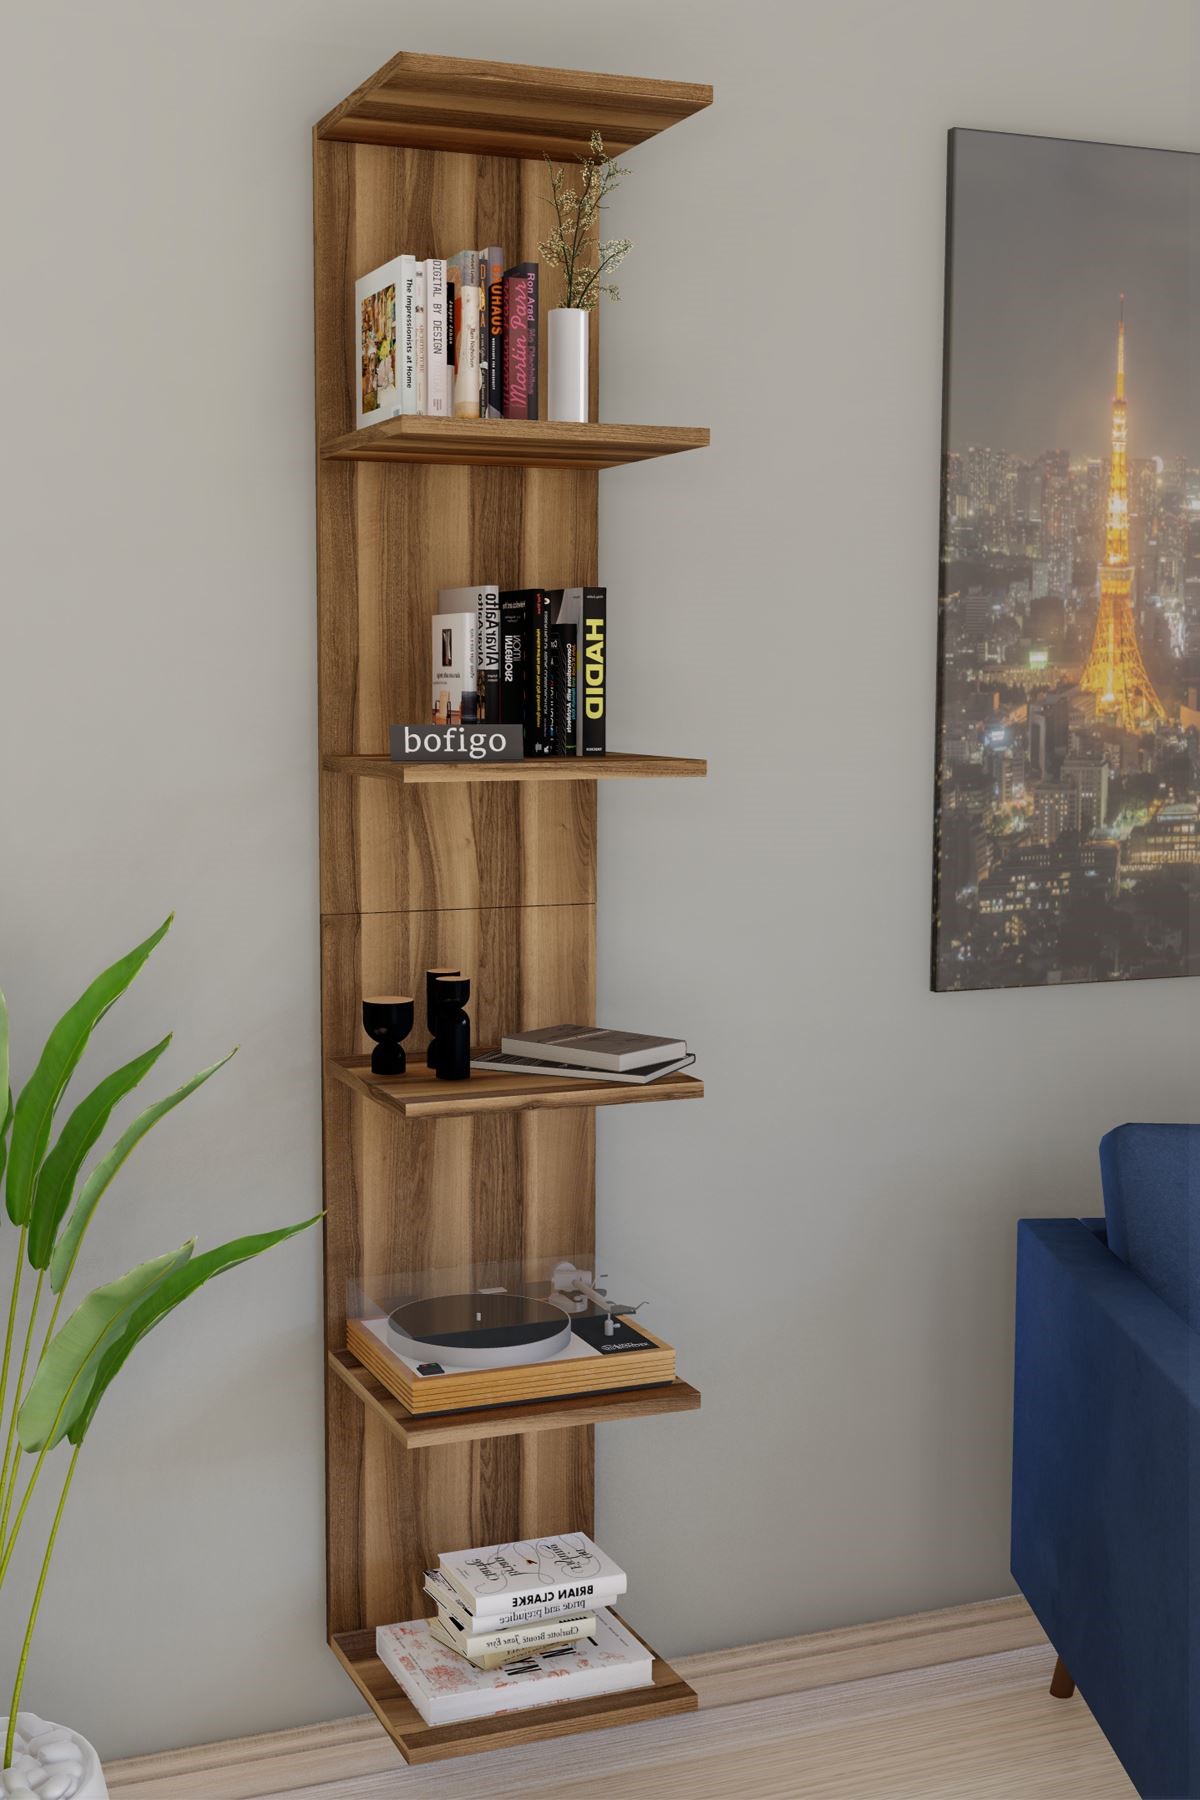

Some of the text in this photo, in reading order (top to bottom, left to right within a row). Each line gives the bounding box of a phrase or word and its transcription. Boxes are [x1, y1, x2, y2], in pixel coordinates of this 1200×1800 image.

[405, 295, 413, 353] Impressionists
[433, 260, 442, 355] DIGITAL BY DESIGN
[491, 263, 503, 335] BAUHAUS
[527, 272, 536, 321] Ron Arad
[406, 355, 413, 363] at
[510, 281, 527, 407] Martin Parr
[404, 726, 507, 759] bofigo
